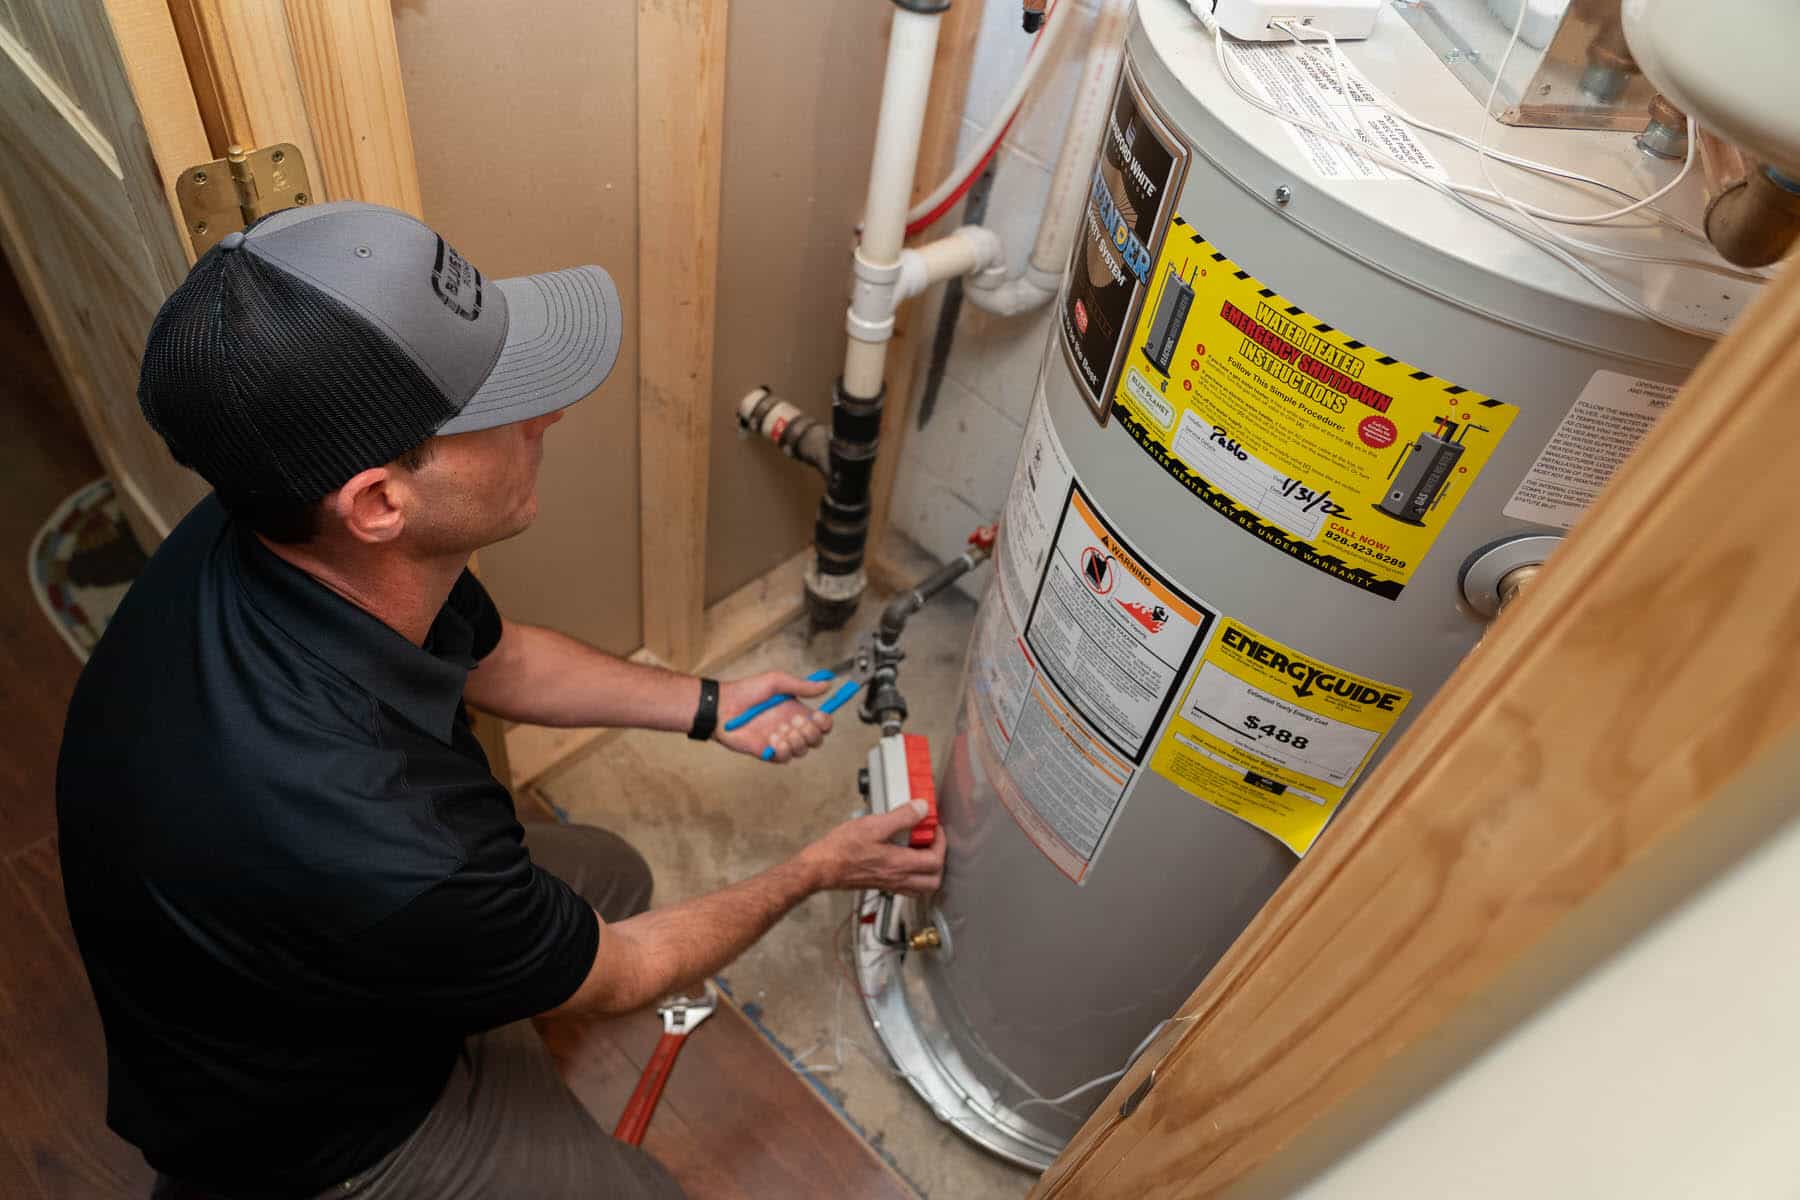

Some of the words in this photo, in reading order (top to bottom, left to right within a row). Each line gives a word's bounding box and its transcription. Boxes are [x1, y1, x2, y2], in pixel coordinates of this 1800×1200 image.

[1130, 157, 1157, 198] WHITE
[1098, 240, 1127, 287] SYSTEM
[1220, 300, 1301, 365] EMERGENCY
[1298, 353, 1393, 414] SHUTDOWN
[1255, 301, 1307, 347] WATER
[1304, 334, 1365, 379] HEATER
[1227, 356, 1251, 377] Follow
[1253, 373, 1269, 389] This
[1270, 385, 1297, 407] Simple
[1298, 402, 1346, 432] Procedure:
[1239, 337, 1348, 414] INSTRUCTIONS
[1210, 425, 1248, 461] Pablo
[1123, 417, 1141, 439] THIS
[1142, 438, 1170, 467] WATER
[1172, 466, 1210, 500] HEATER
[1213, 499, 1235, 517] MAY
[1239, 515, 1254, 530] BE
[1257, 527, 1298, 555] UNDER
[1303, 552, 1374, 588] WARRANTY
[1282, 478, 1352, 521] 1/31/22
[1325, 530, 1407, 569] 828.423.6289
[1330, 522, 1358, 539] CALL
[1359, 535, 1390, 553] NOW!
[1110, 543, 1153, 587] WARNING
[1245, 688, 1276, 704] Estimated
[1274, 701, 1293, 713] Yearly
[1292, 708, 1314, 721] Energy
[1313, 716, 1329, 726] Cost
[1243, 714, 1309, 751] $488
